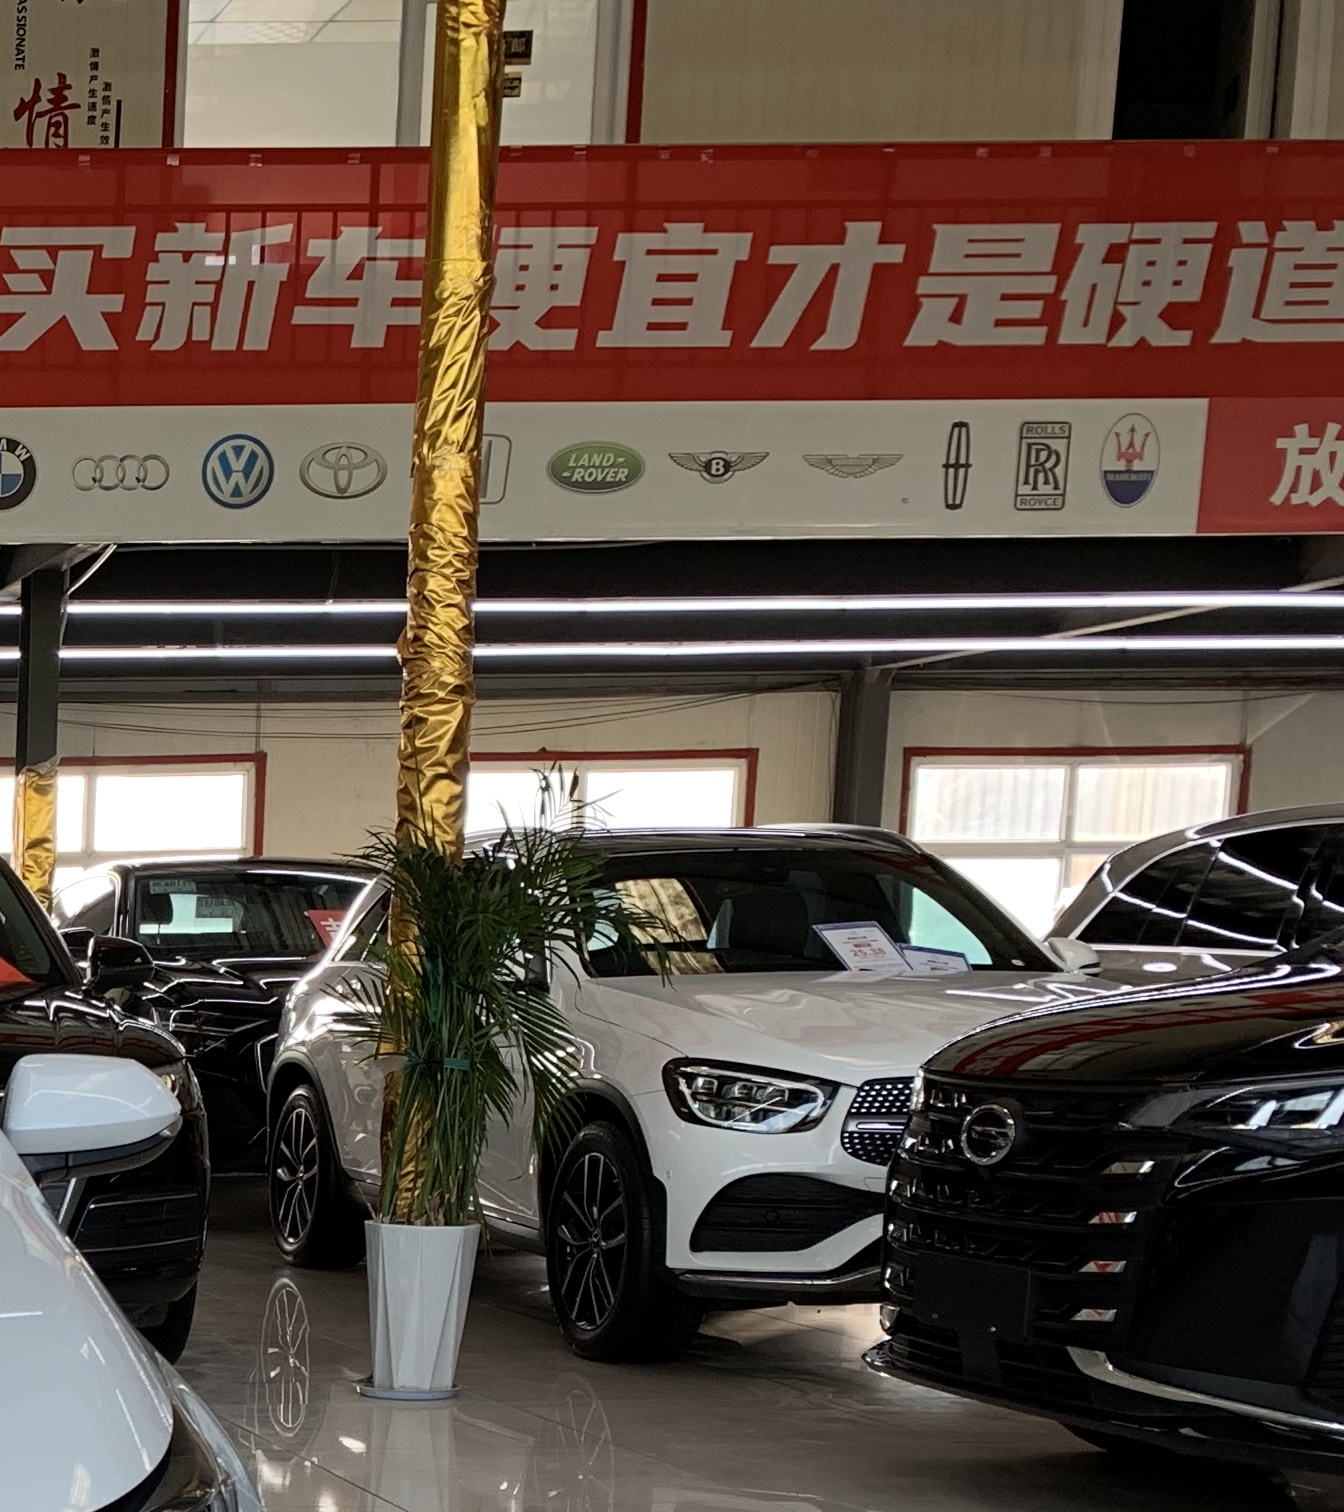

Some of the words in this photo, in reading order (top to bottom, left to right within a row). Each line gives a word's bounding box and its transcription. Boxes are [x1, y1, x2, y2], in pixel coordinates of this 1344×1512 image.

[86, 48, 100, 126] 激情产生速度
[1025, 425, 1066, 435] ROLLS
[1019, 497, 1060, 507] ROYCE
